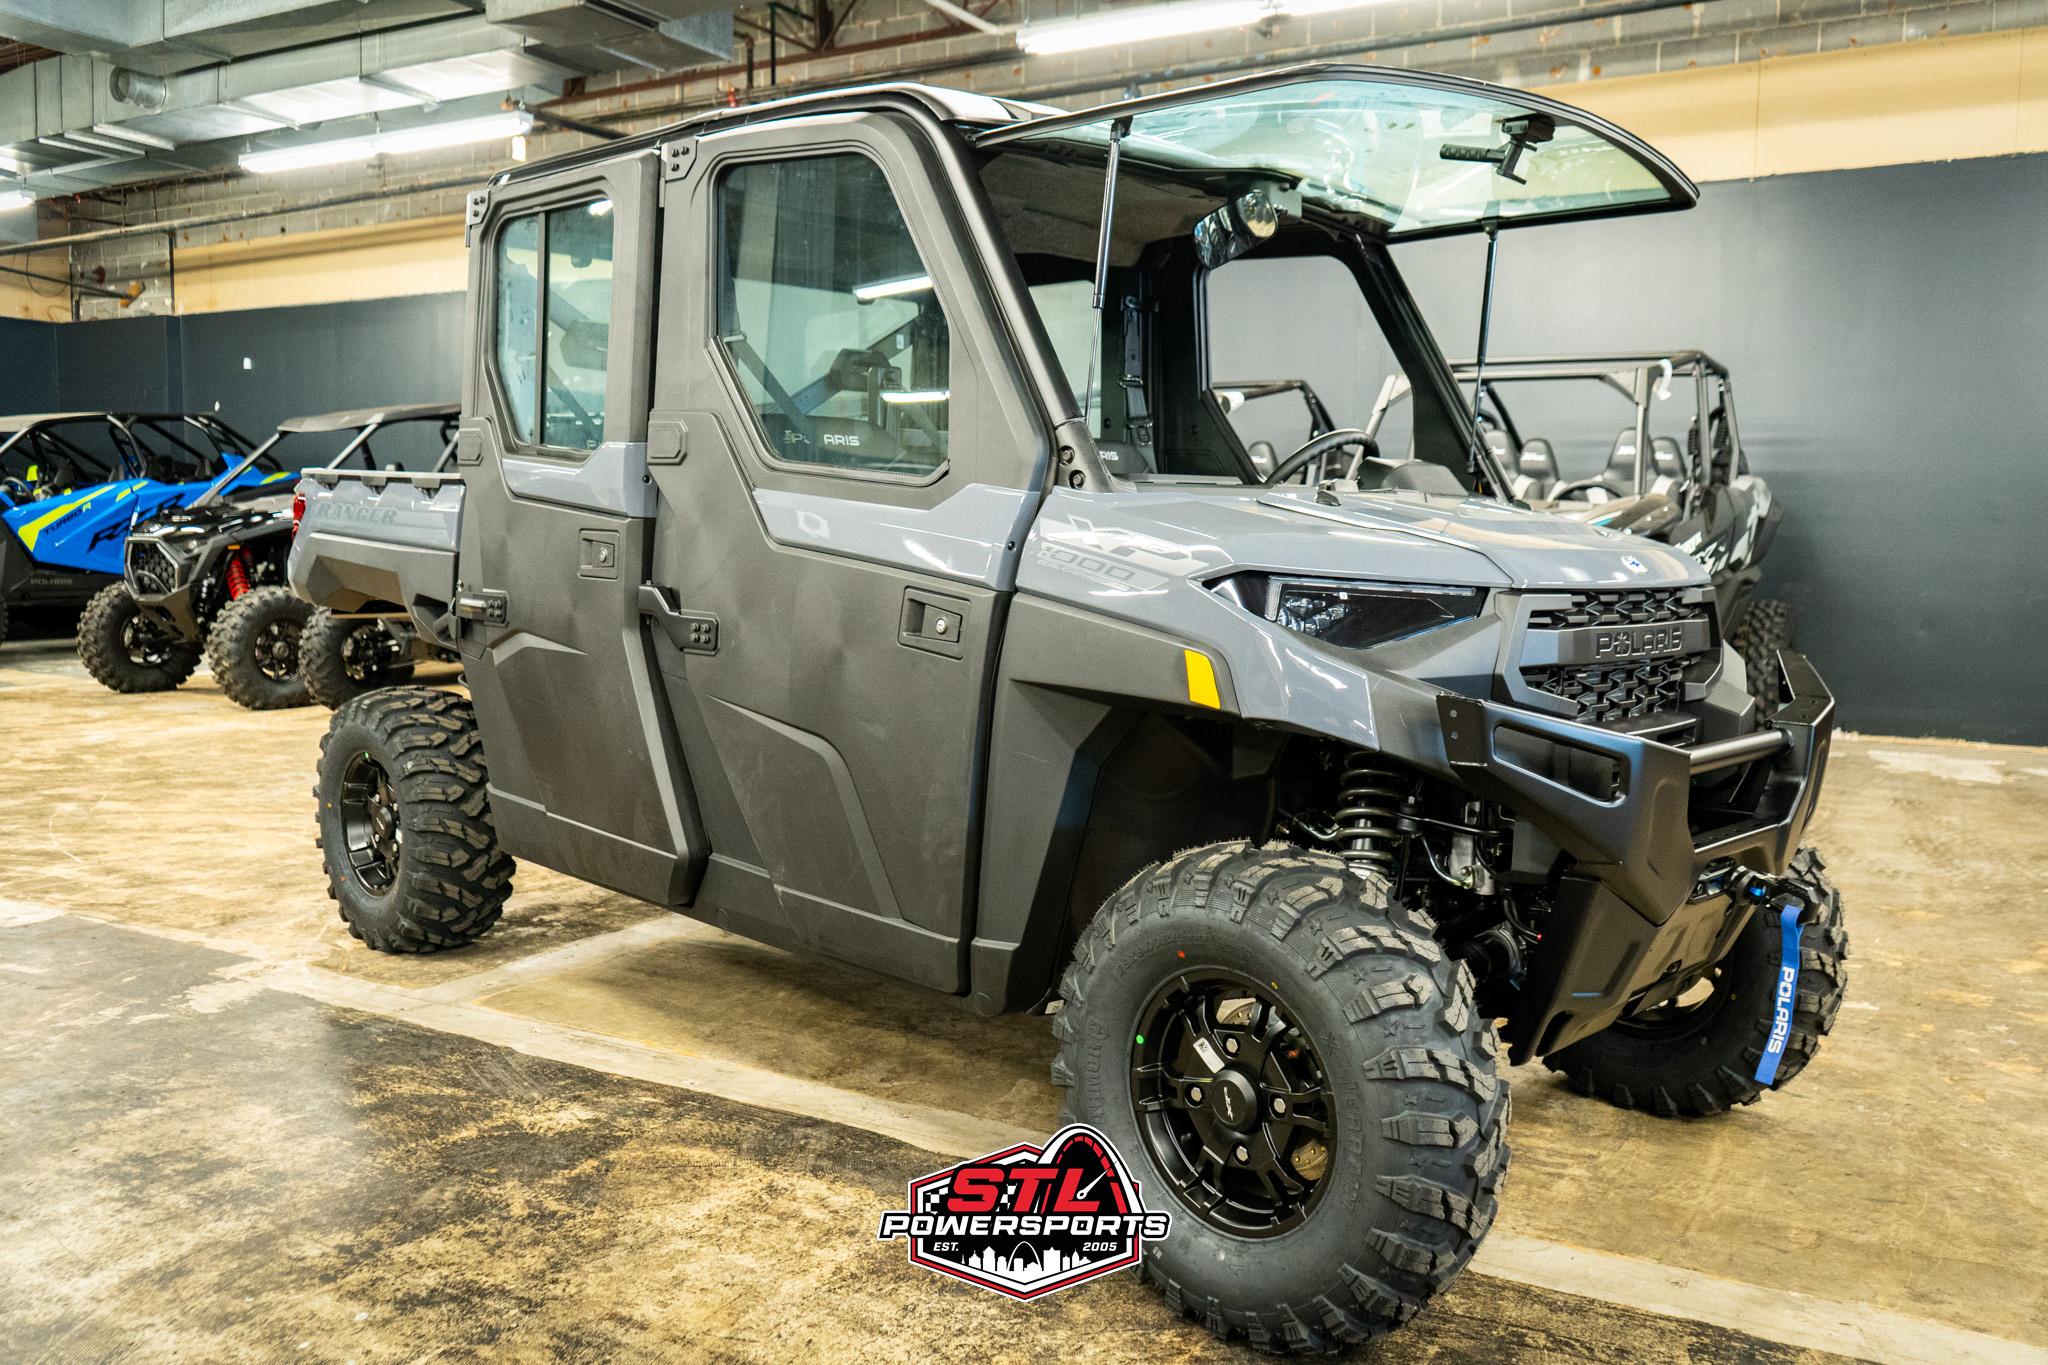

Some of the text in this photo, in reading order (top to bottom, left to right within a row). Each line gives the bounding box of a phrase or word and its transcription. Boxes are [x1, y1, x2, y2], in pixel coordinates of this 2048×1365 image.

[43, 509, 82, 536] TURBO
[316, 501, 397, 524] RANGER
[30, 578, 73, 586] POLARIS
[1595, 627, 1682, 658] POLARIS
[1767, 966, 1795, 1054] POLARIS
